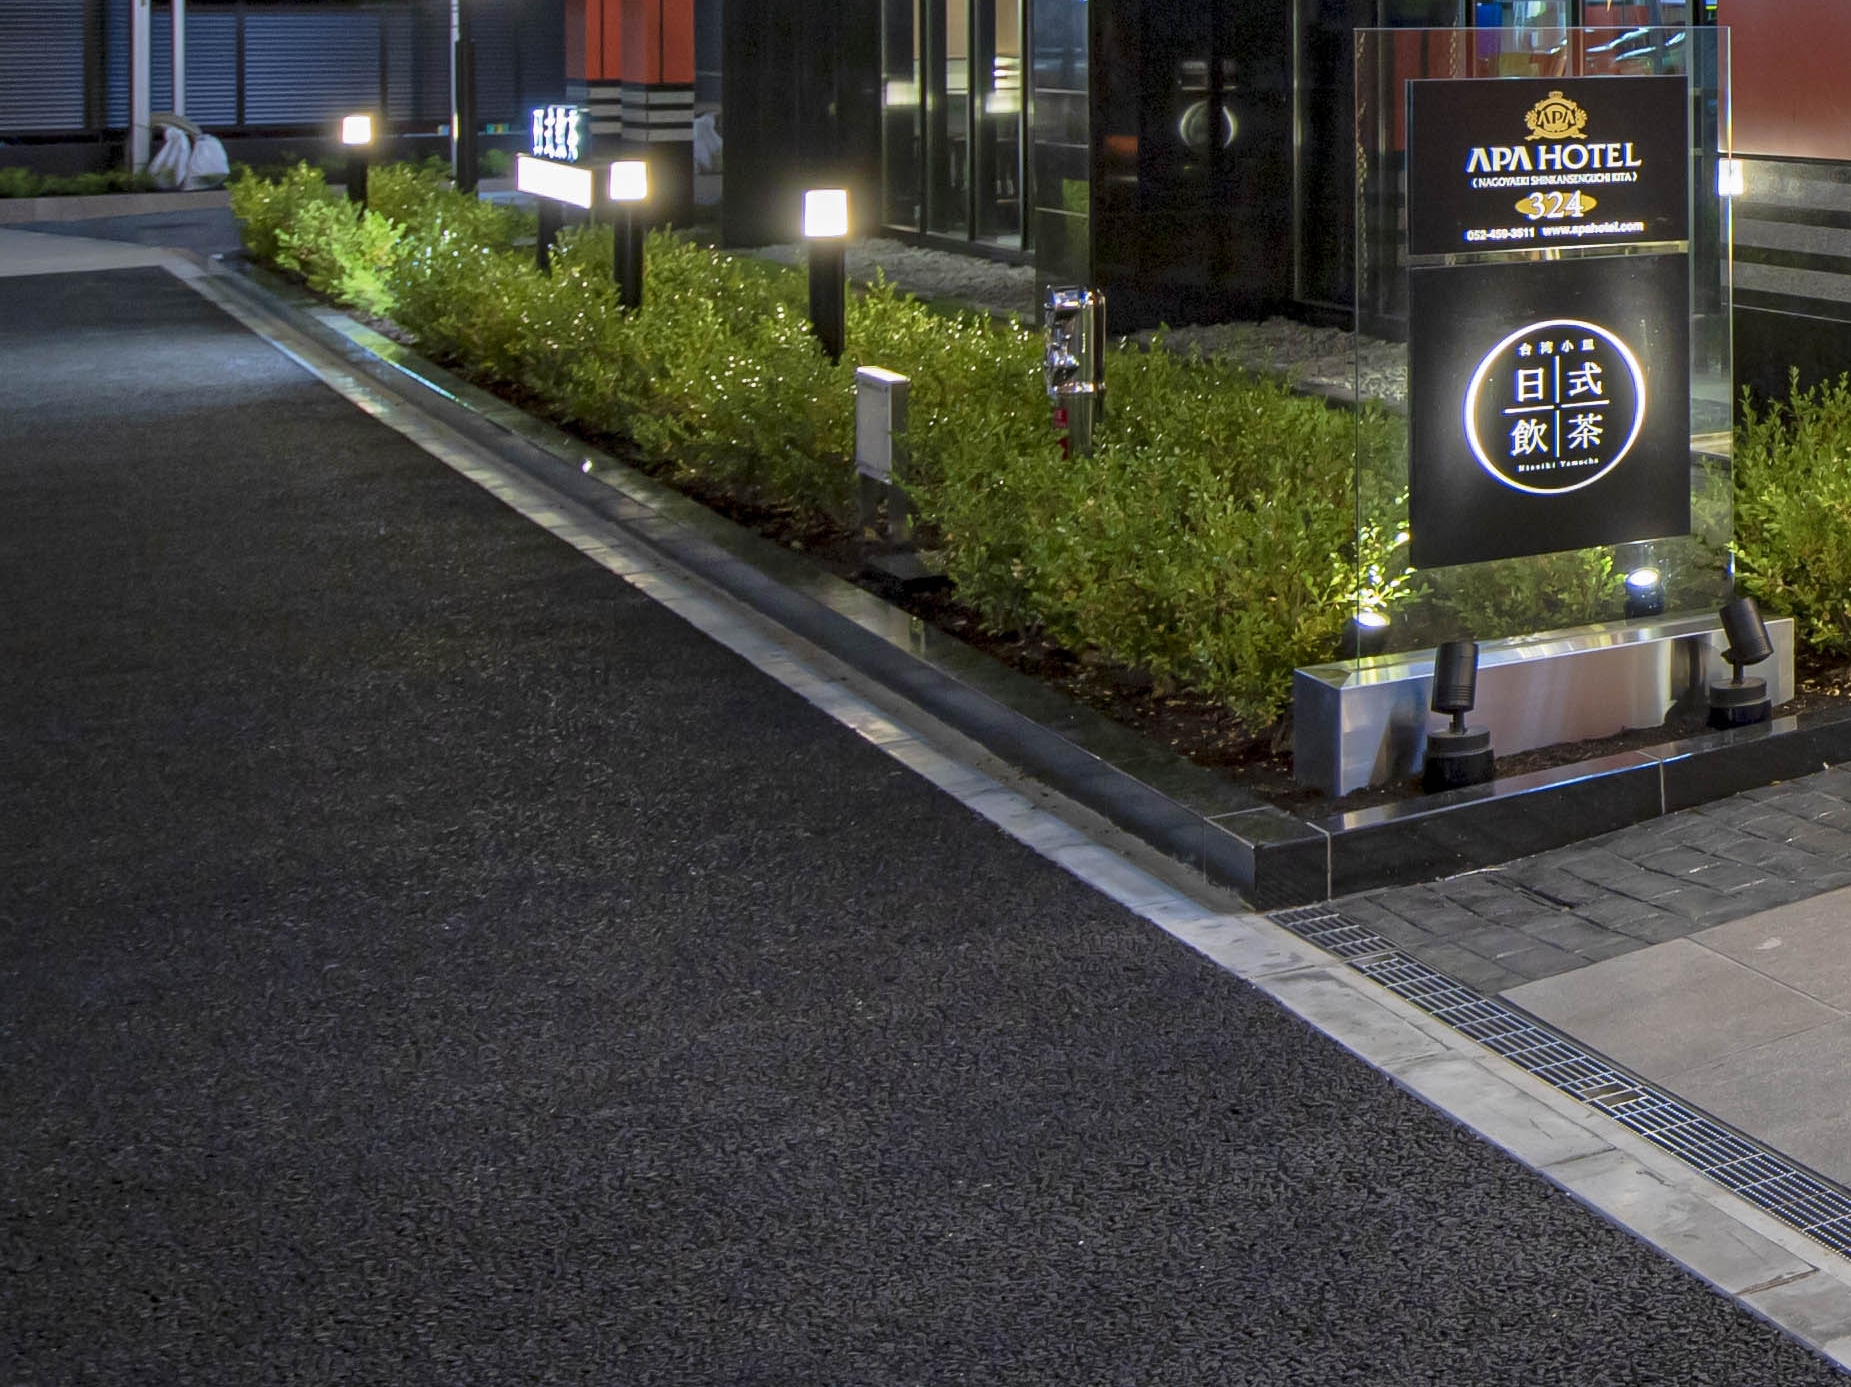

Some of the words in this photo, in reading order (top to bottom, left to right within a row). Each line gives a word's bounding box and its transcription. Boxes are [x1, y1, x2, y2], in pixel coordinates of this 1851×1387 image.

[1537, 110, 1577, 126] APA
[1465, 145, 1534, 173] APA
[1536, 142, 1643, 171] HOTEL
[1525, 189, 1585, 221] 324
